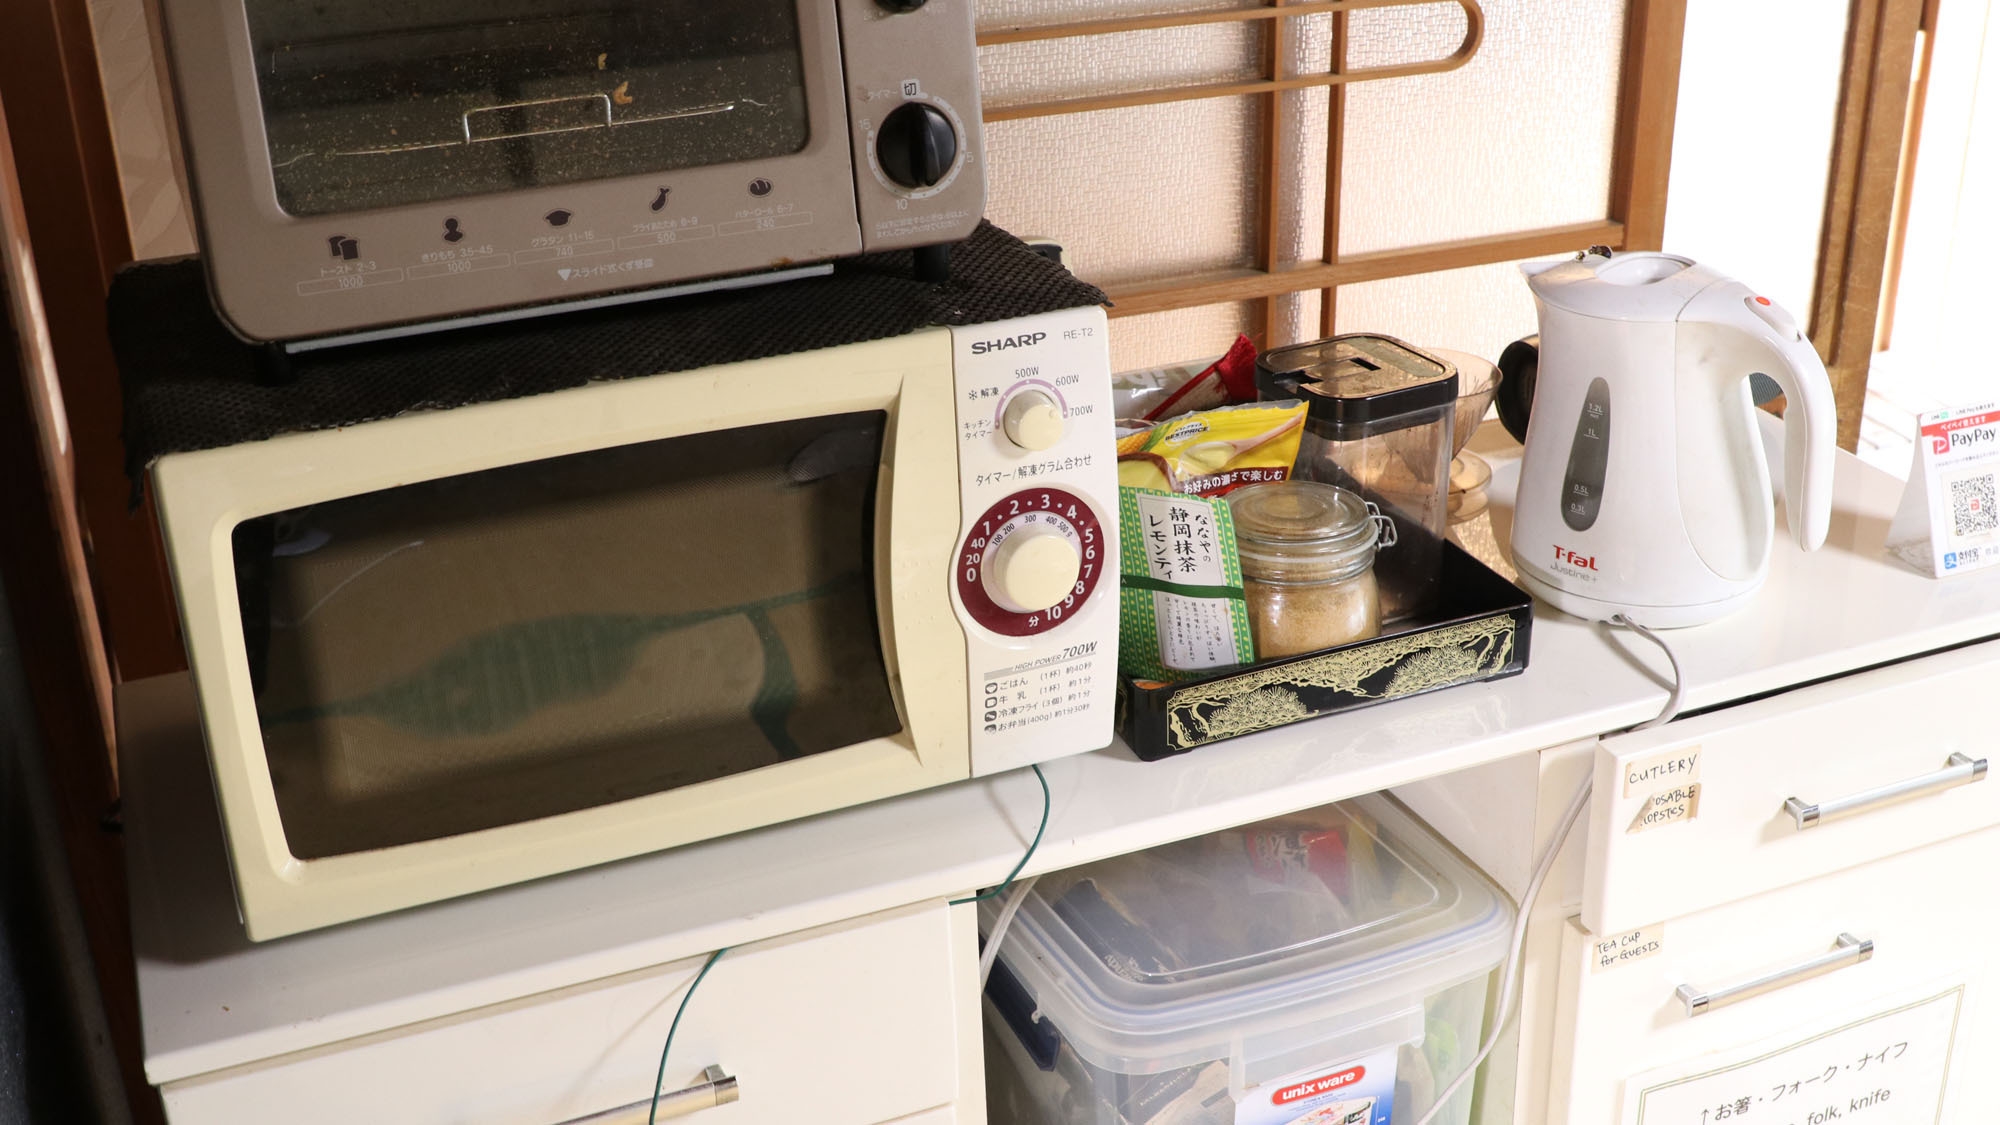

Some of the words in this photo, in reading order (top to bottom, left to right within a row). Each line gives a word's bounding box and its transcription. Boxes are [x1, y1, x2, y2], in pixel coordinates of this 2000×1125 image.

[904, 82, 917, 96] 切
[859, 119, 871, 130] 15
[966, 152, 974, 163] 5
[896, 199, 908, 210] 10
[555, 245, 574, 257] 740
[320, 264, 354, 278] トースト
[447, 260, 472, 272] 1000
[338, 275, 364, 288] 1000
[1063, 328, 1094, 340] RE-T2
[971, 332, 1047, 355] SHARP
[1015, 367, 1040, 379] 500W
[1055, 375, 1080, 387] 600W
[980, 387, 1000, 398] 解凍
[1069, 405, 1094, 417] 700W
[964, 419, 992, 430] キッチン
[965, 430, 993, 440] タイマー
[1164, 426, 1210, 441] BESTPRICE
[1587, 428, 1597, 437] 1L
[1951, 428, 1997, 448] PayPay
[1183, 469, 1284, 495] お好みの濃さで楽しむ
[1574, 484, 1589, 495] 0.5L
[1009, 500, 1020, 515] 2
[1041, 494, 1050, 509] 3
[1571, 502, 1586, 513] 0.3L
[1066, 504, 1077, 519] 4
[982, 521, 991, 536] 1
[992, 534, 1004, 546] 100
[1003, 523, 1015, 535] 200
[1024, 514, 1037, 523] 300
[1045, 516, 1058, 526] 400
[1057, 521, 1069, 533] 500
[1084, 528, 1094, 543] 5
[971, 537, 985, 549] 40
[1169, 507, 1198, 573] 静岡抹茶
[1195, 514, 1212, 563] ななやの
[1085, 545, 1096, 560] 6
[1150, 514, 1173, 580] レモンティ
[966, 552, 981, 565] 20
[1552, 544, 1599, 571] T-fal
[966, 567, 977, 582] 0
[1084, 564, 1093, 578] 7
[1075, 580, 1085, 595] 8
[1064, 594, 1074, 608] 9
[1045, 605, 1062, 621] 10
[1028, 615, 1039, 627] 分
[1014, 661, 1033, 671] HIGH
[1034, 654, 1062, 666] POWER
[1062, 641, 1098, 659] 700W
[1000, 677, 1029, 690] ごはん
[1629, 753, 1698, 785] CUTLERY
[1654, 785, 1697, 806] OSABLE
[1596, 939, 1617, 954] TEA
[1600, 954, 1619, 967] for
[1619, 941, 1660, 959] GUESTS
[1282, 1081, 1315, 1100] unix
[1317, 1071, 1356, 1091] ware
[1714, 1041, 1910, 1120] お箸・フォーク・ナイフ
[1807, 1106, 1843, 1125] folk,
[1849, 1088, 1892, 1112] knife
